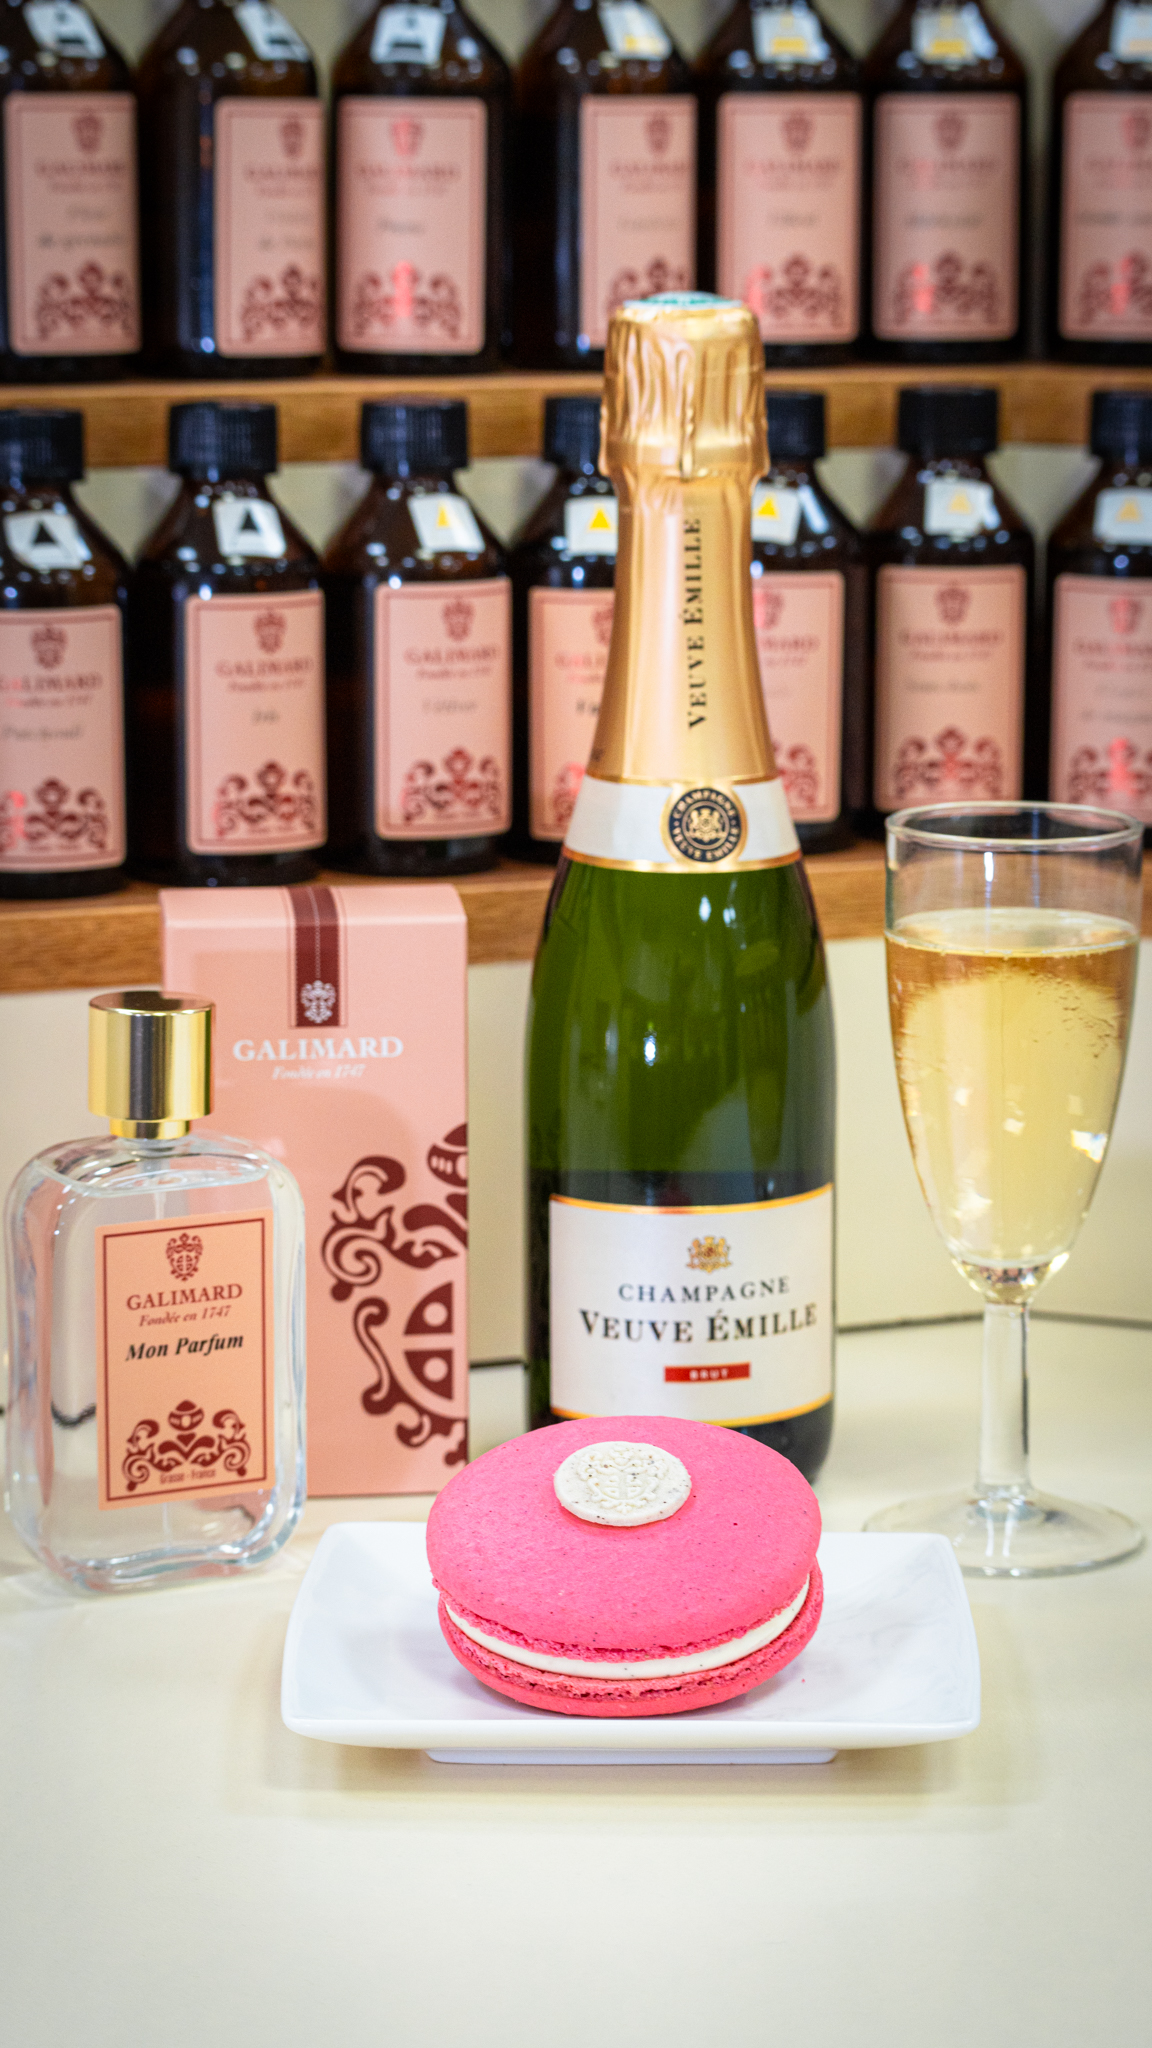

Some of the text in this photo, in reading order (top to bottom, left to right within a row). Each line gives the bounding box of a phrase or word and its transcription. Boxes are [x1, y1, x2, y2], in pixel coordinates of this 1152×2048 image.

[686, 634, 707, 729] VEUVE
[232, 1036, 404, 1062] GALIMARD
[126, 1283, 243, 1311] GALIMARD
[618, 1276, 791, 1304] CHAMPAGNE
[139, 1304, 232, 1327] Fondée en 1747
[125, 1333, 244, 1362] Mon Parfum
[689, 1367, 729, 1381] BRUT
